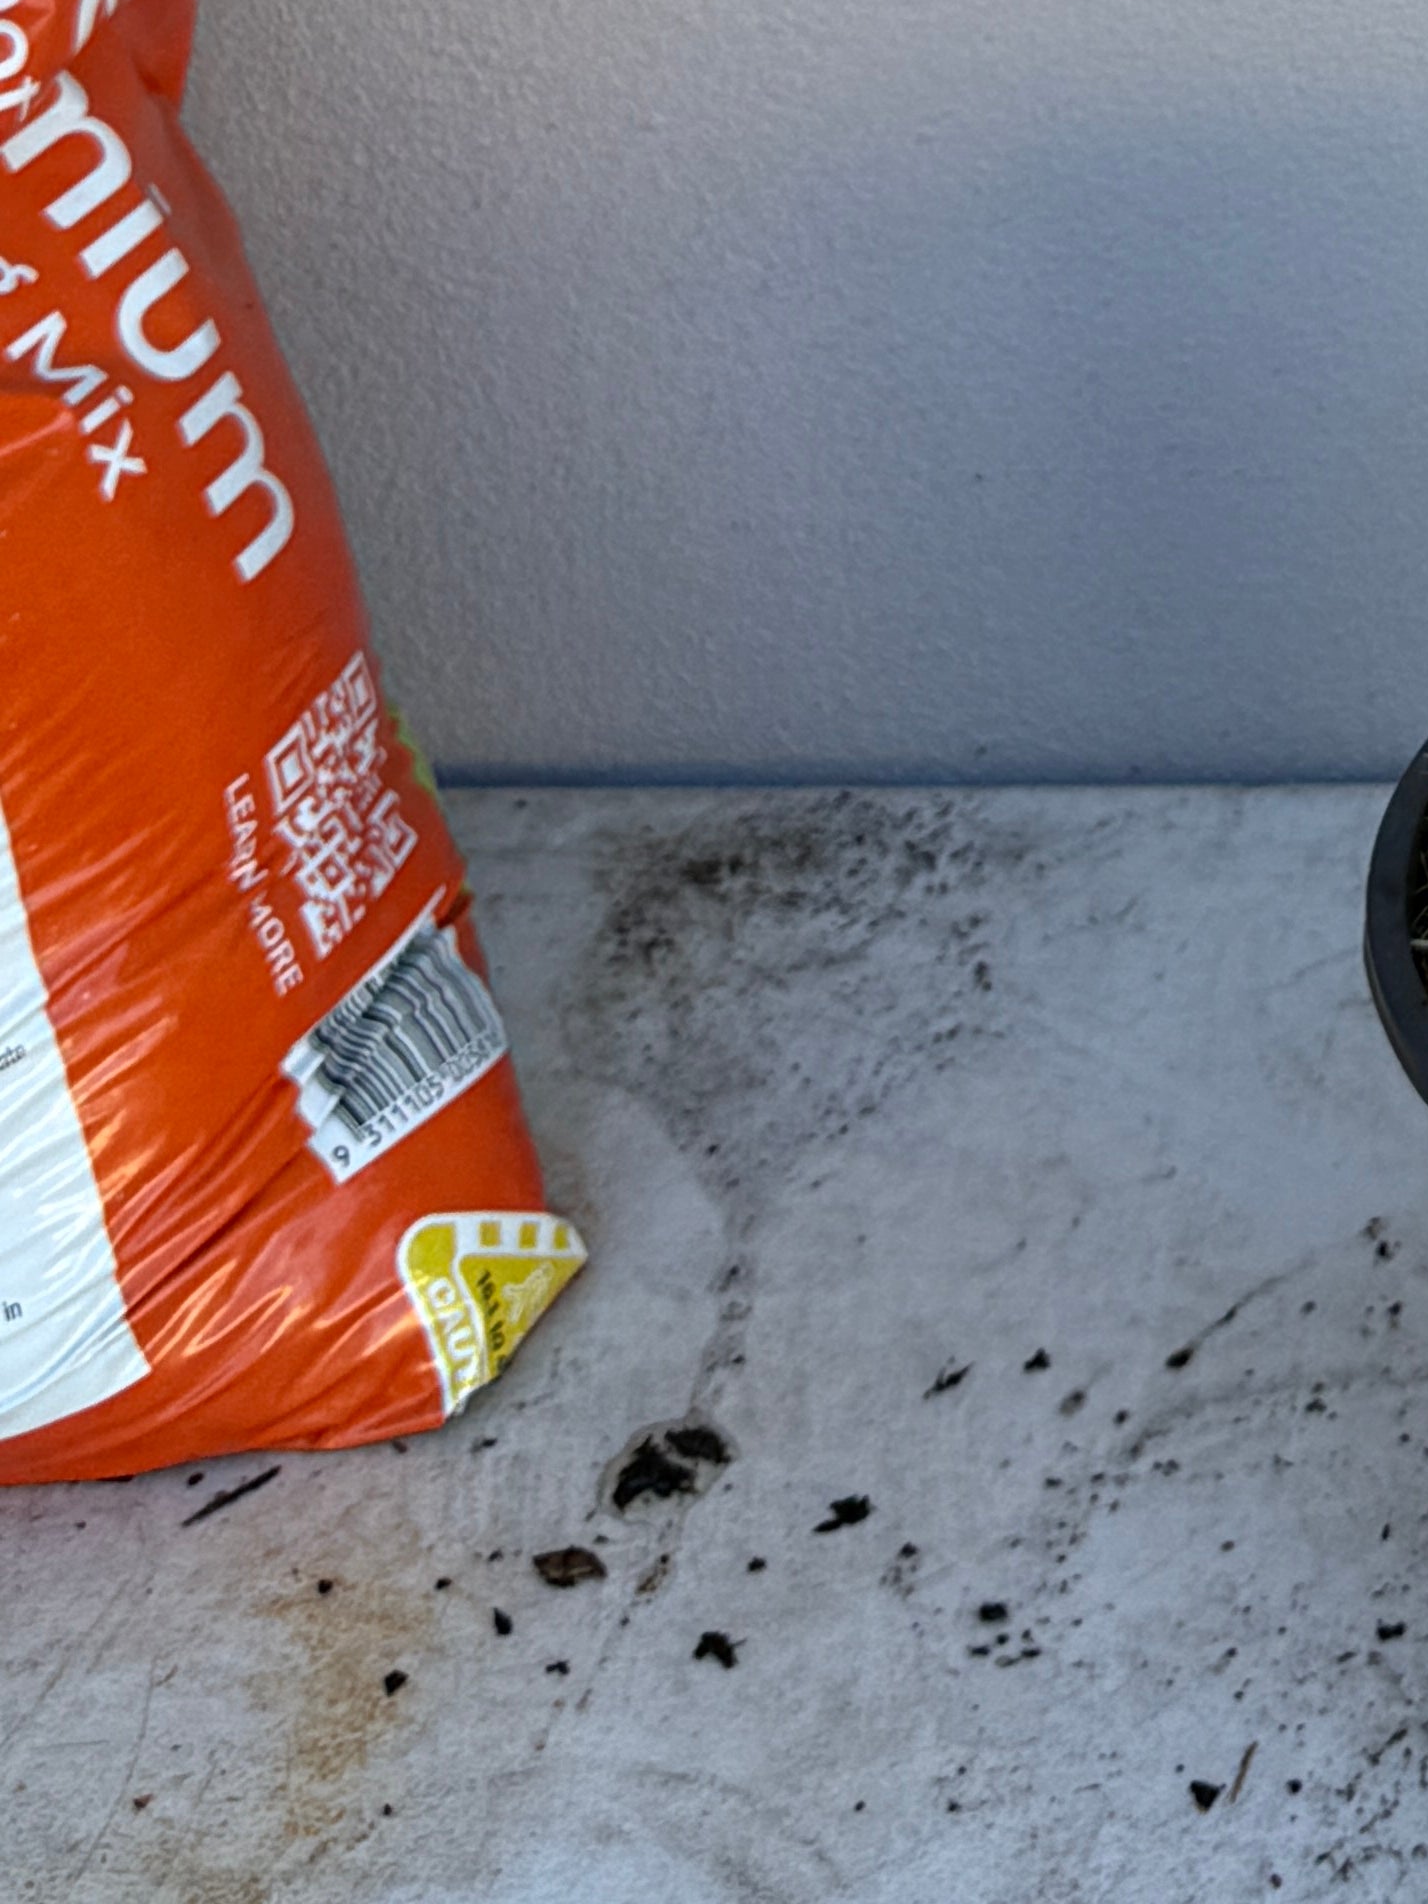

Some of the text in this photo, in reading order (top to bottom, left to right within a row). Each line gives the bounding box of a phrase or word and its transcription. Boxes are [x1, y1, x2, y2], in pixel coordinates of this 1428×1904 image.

[4, 309, 149, 503] Mix
[224, 772, 304, 998] LEARN MORE
[3, 1299, 23, 1322] in
